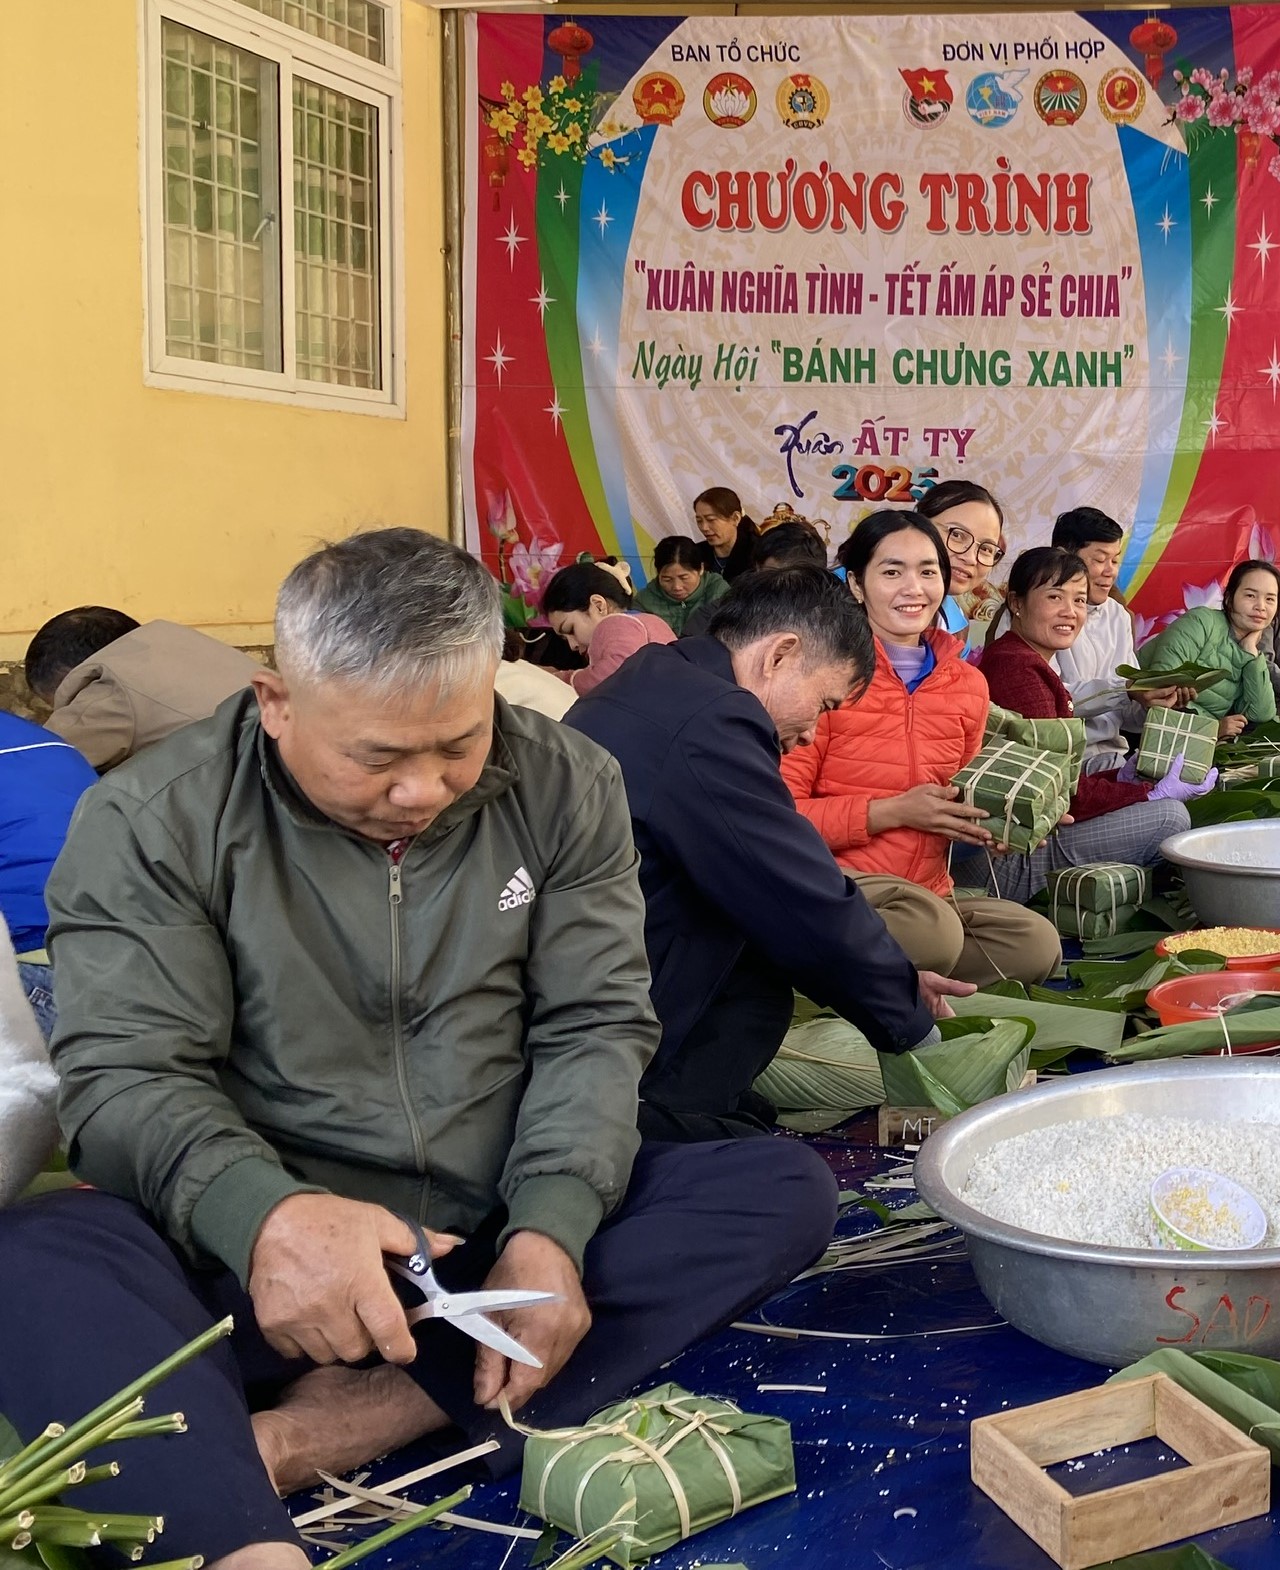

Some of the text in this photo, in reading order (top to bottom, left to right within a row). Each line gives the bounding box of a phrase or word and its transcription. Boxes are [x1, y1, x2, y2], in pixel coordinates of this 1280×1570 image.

[671, 37, 801, 62] BAN TỔ CHỨC
[942, 36, 1105, 65] ĐƠN VỊ PHỐI HỢP
[681, 156, 1093, 235] CHƯƠNG TRÌNH
[721, 264, 799, 314] NGHĨA
[805, 263, 863, 315] TÌNH
[885, 261, 932, 316] TẾT
[935, 261, 976, 316] ẤM
[981, 264, 1015, 316] ÁP
[1020, 261, 1053, 317] SẺ
[631, 340, 703, 391] Ngày
[713, 343, 761, 393] Hội
[892, 342, 1012, 387] CHƯNG
[852, 415, 909, 456] ẤT
[923, 428, 976, 464] TỴ
[831, 464, 939, 502] 2025
[497, 888, 537, 912] adid
